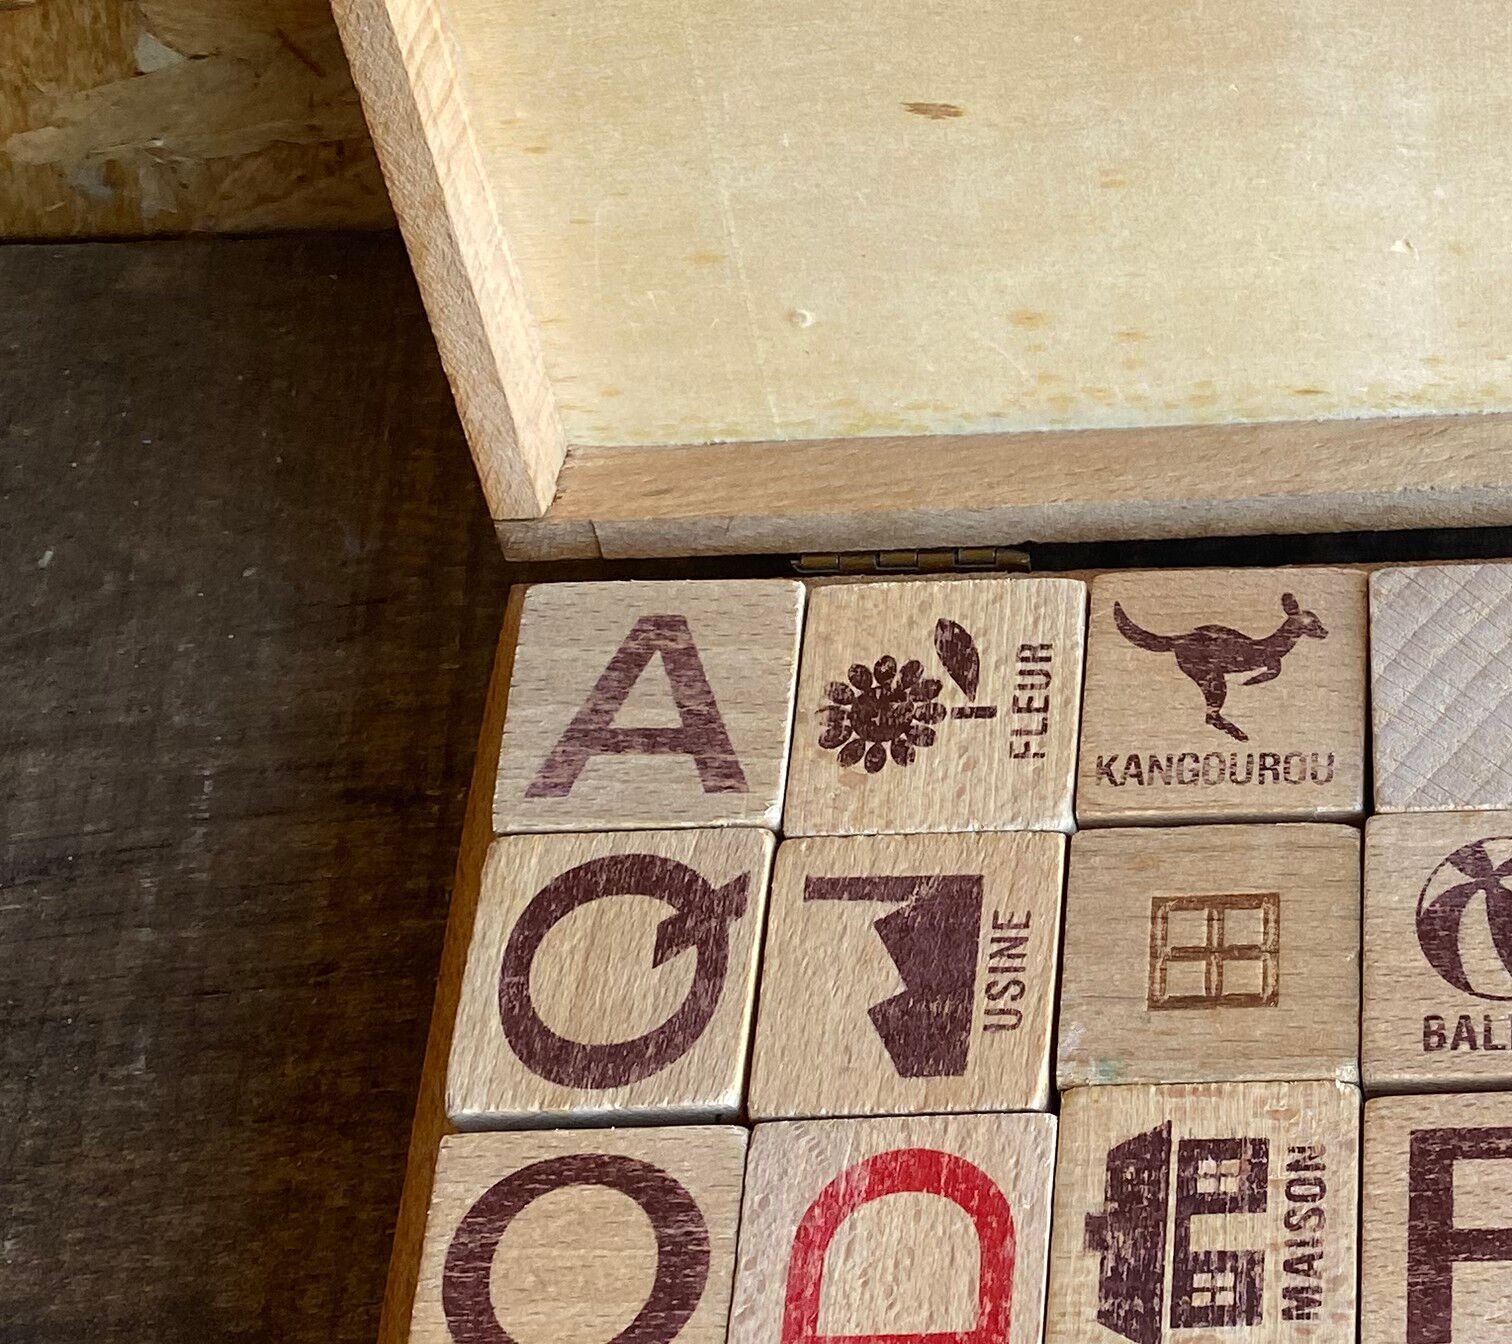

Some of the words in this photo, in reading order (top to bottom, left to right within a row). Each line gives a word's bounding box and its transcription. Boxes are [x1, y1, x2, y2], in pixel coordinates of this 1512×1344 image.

[524, 614, 749, 798] A
[1008, 641, 1053, 761] FLEUR
[1095, 751, 1336, 788] KANGOUROU
[500, 852, 750, 1090] Q
[981, 908, 1033, 1034] USINE
[1280, 1144, 1328, 1322] MAISON
